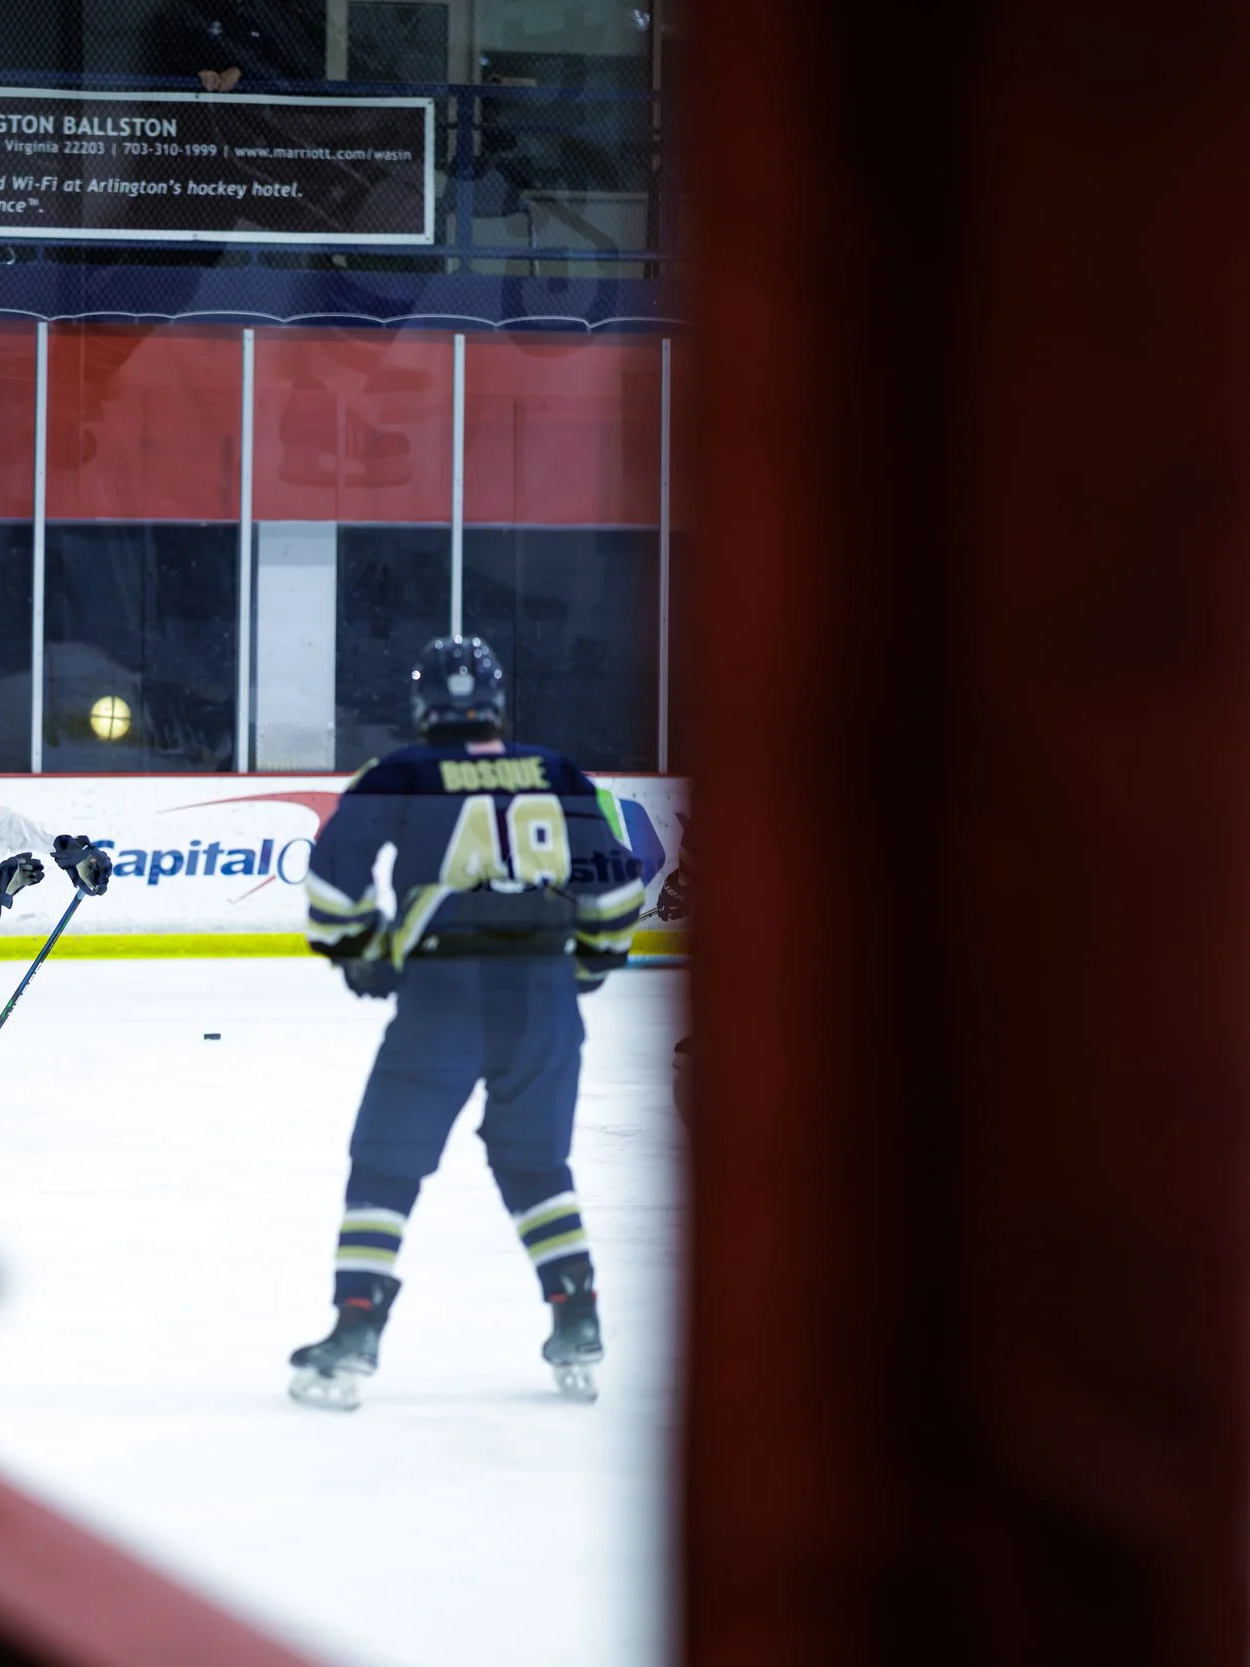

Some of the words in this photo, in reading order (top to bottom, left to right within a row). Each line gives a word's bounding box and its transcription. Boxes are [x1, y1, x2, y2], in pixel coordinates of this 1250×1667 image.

[63, 116, 177, 137] BALLSTON
[5, 139, 59, 155] Virginia
[63, 141, 105, 154] 22203
[123, 142, 217, 156] 703-310-1999
[234, 146, 412, 161] www.marriott.com/wasin
[12, 176, 59, 192] Wi-Fi
[63, 179, 82, 192] at
[87, 178, 182, 197] Arlington's
[186, 180, 247, 199] hockey
[251, 181, 303, 198] hotel.
[438, 756, 551, 793] BOSQUE
[439, 794, 571, 891] 48
